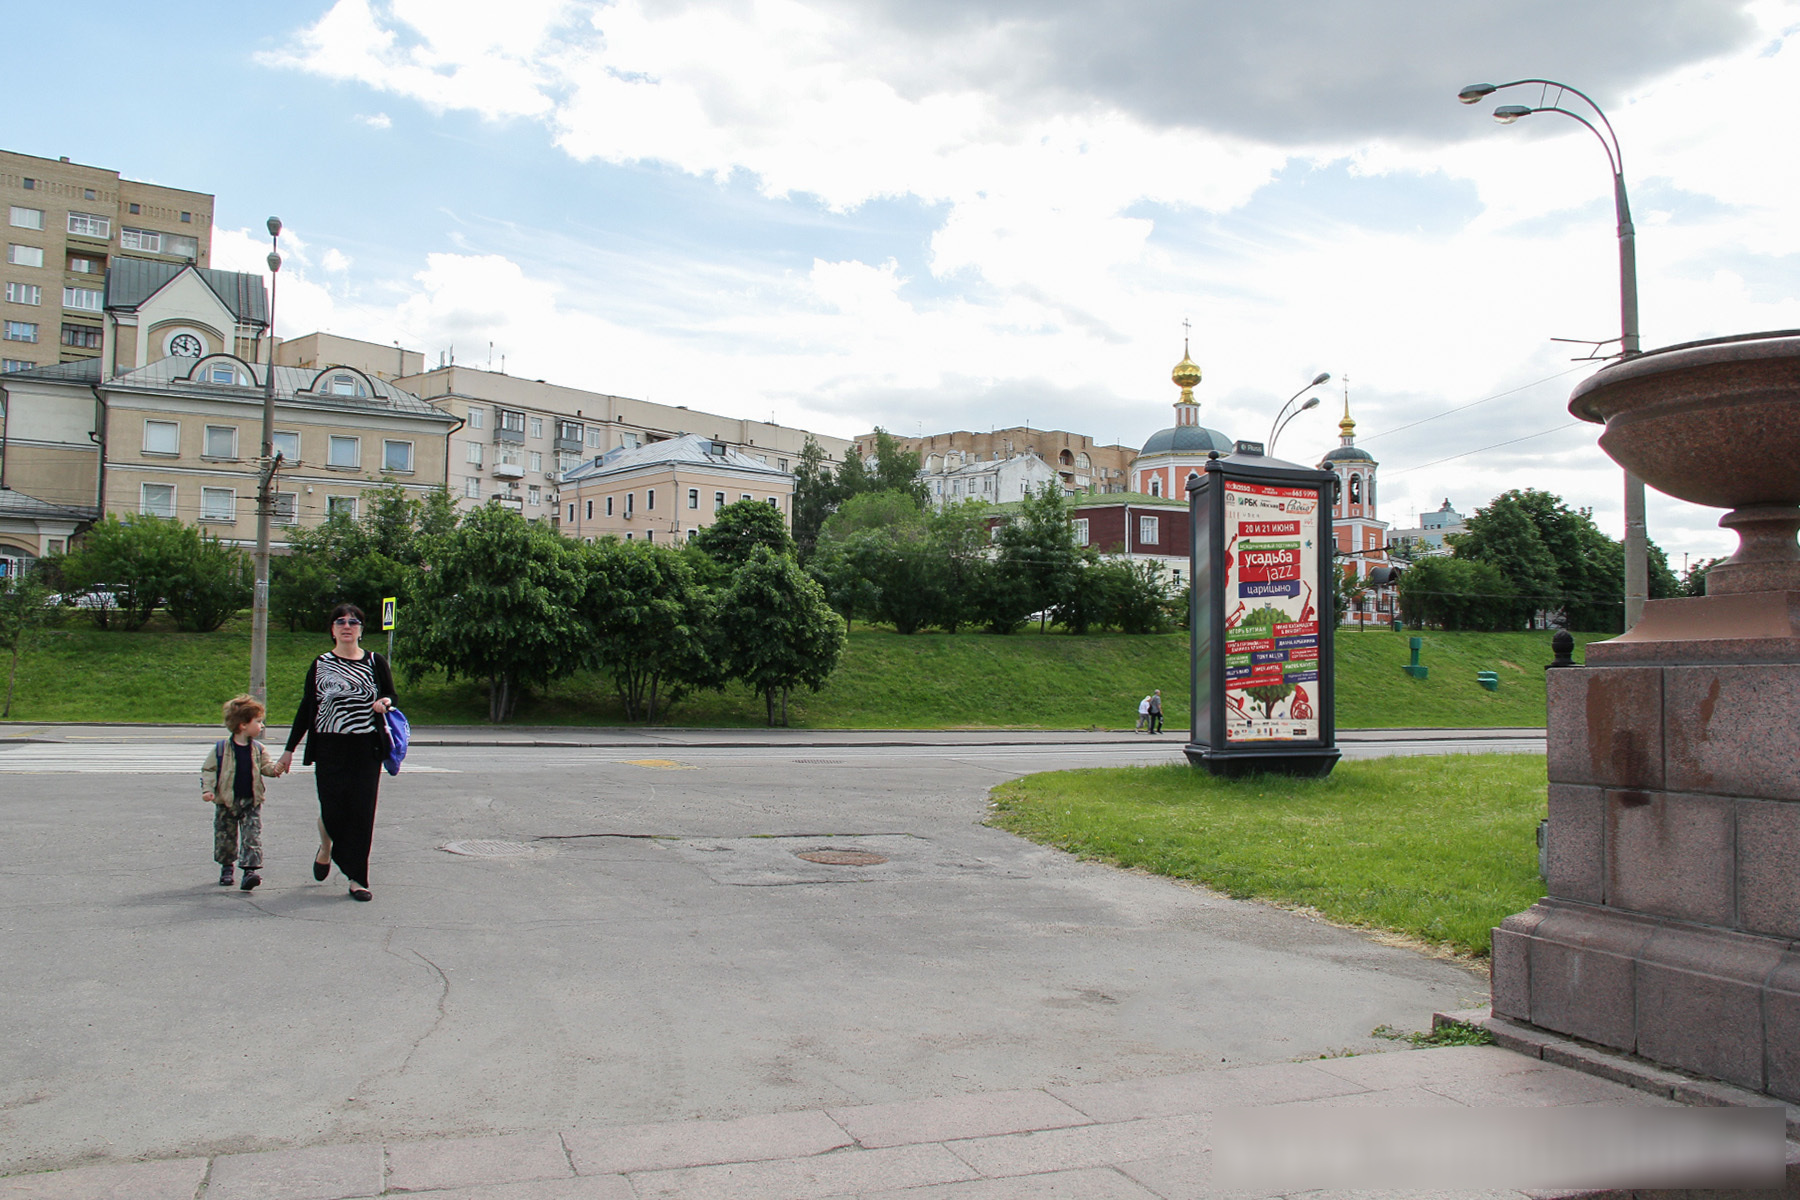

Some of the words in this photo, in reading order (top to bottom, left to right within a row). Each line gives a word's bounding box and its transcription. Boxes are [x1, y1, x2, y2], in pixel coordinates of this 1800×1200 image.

[1244, 497, 1258, 507] РБК
[1246, 525, 1254, 533] 20
[1255, 524, 1261, 532] И
[1262, 525, 1270, 533] 21
[1272, 524, 1295, 533] ИЮНЯ
[1245, 550, 1293, 567] усадьба
[1266, 565, 1293, 585] jazz
[1247, 585, 1291, 595] царицыно
[1245, 626, 1267, 634] БУТМАН
